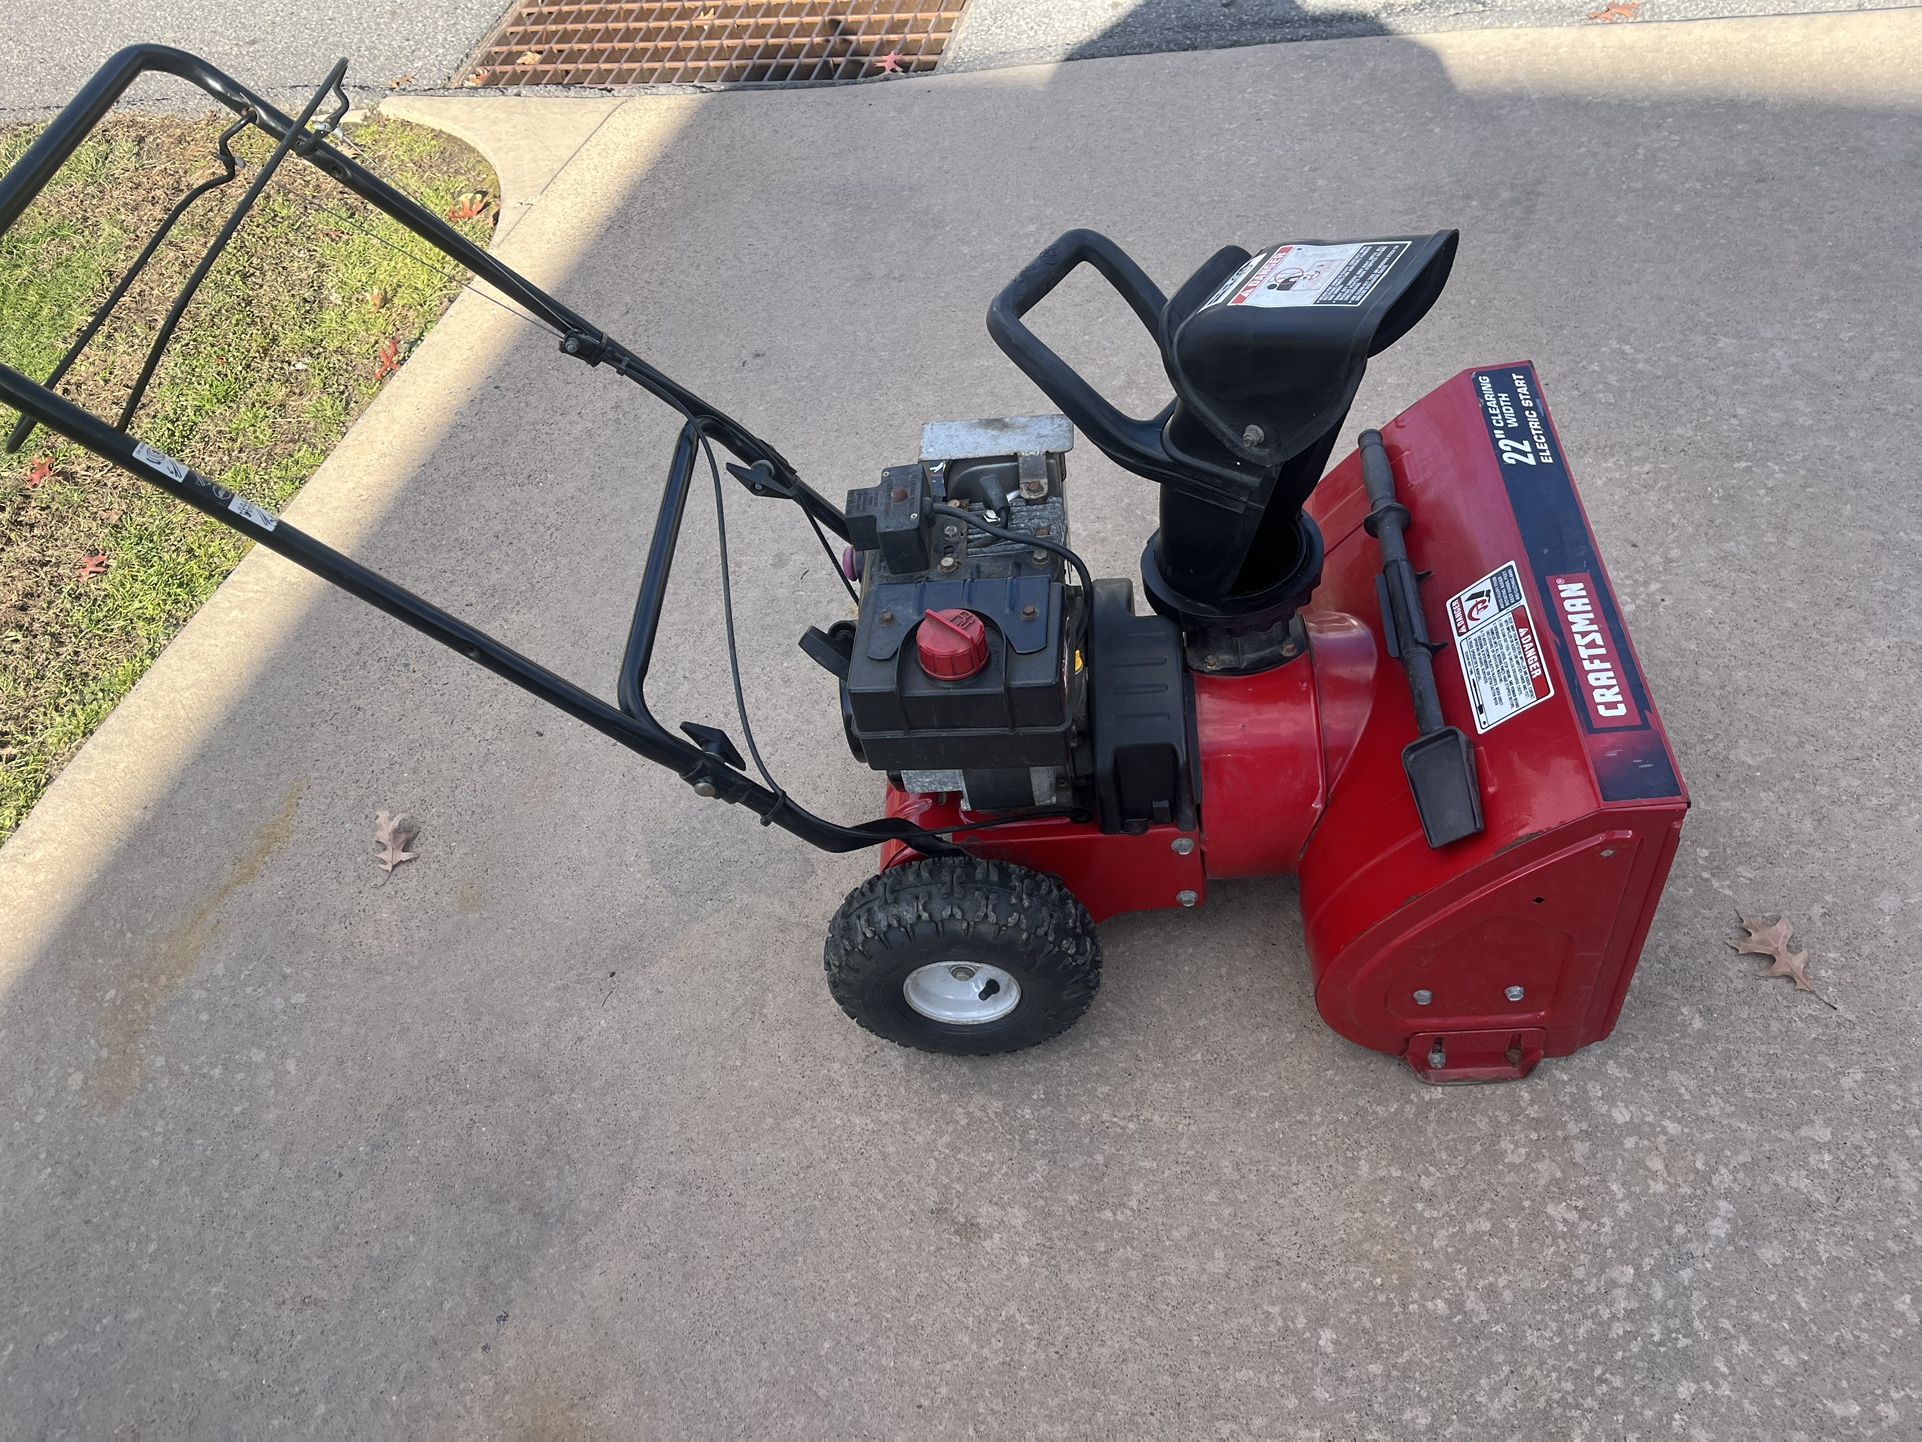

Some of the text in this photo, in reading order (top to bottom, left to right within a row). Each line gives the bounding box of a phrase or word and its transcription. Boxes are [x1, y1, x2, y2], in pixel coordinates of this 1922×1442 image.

[1248, 252, 1287, 287] DANGER
[1479, 376, 1504, 427] CLEARING
[1498, 393, 1518, 428] WIDTH
[1512, 373, 1554, 463] ELECTRIC START
[1452, 599, 1464, 627] DANGER
[1521, 635, 1542, 679] DANGER
